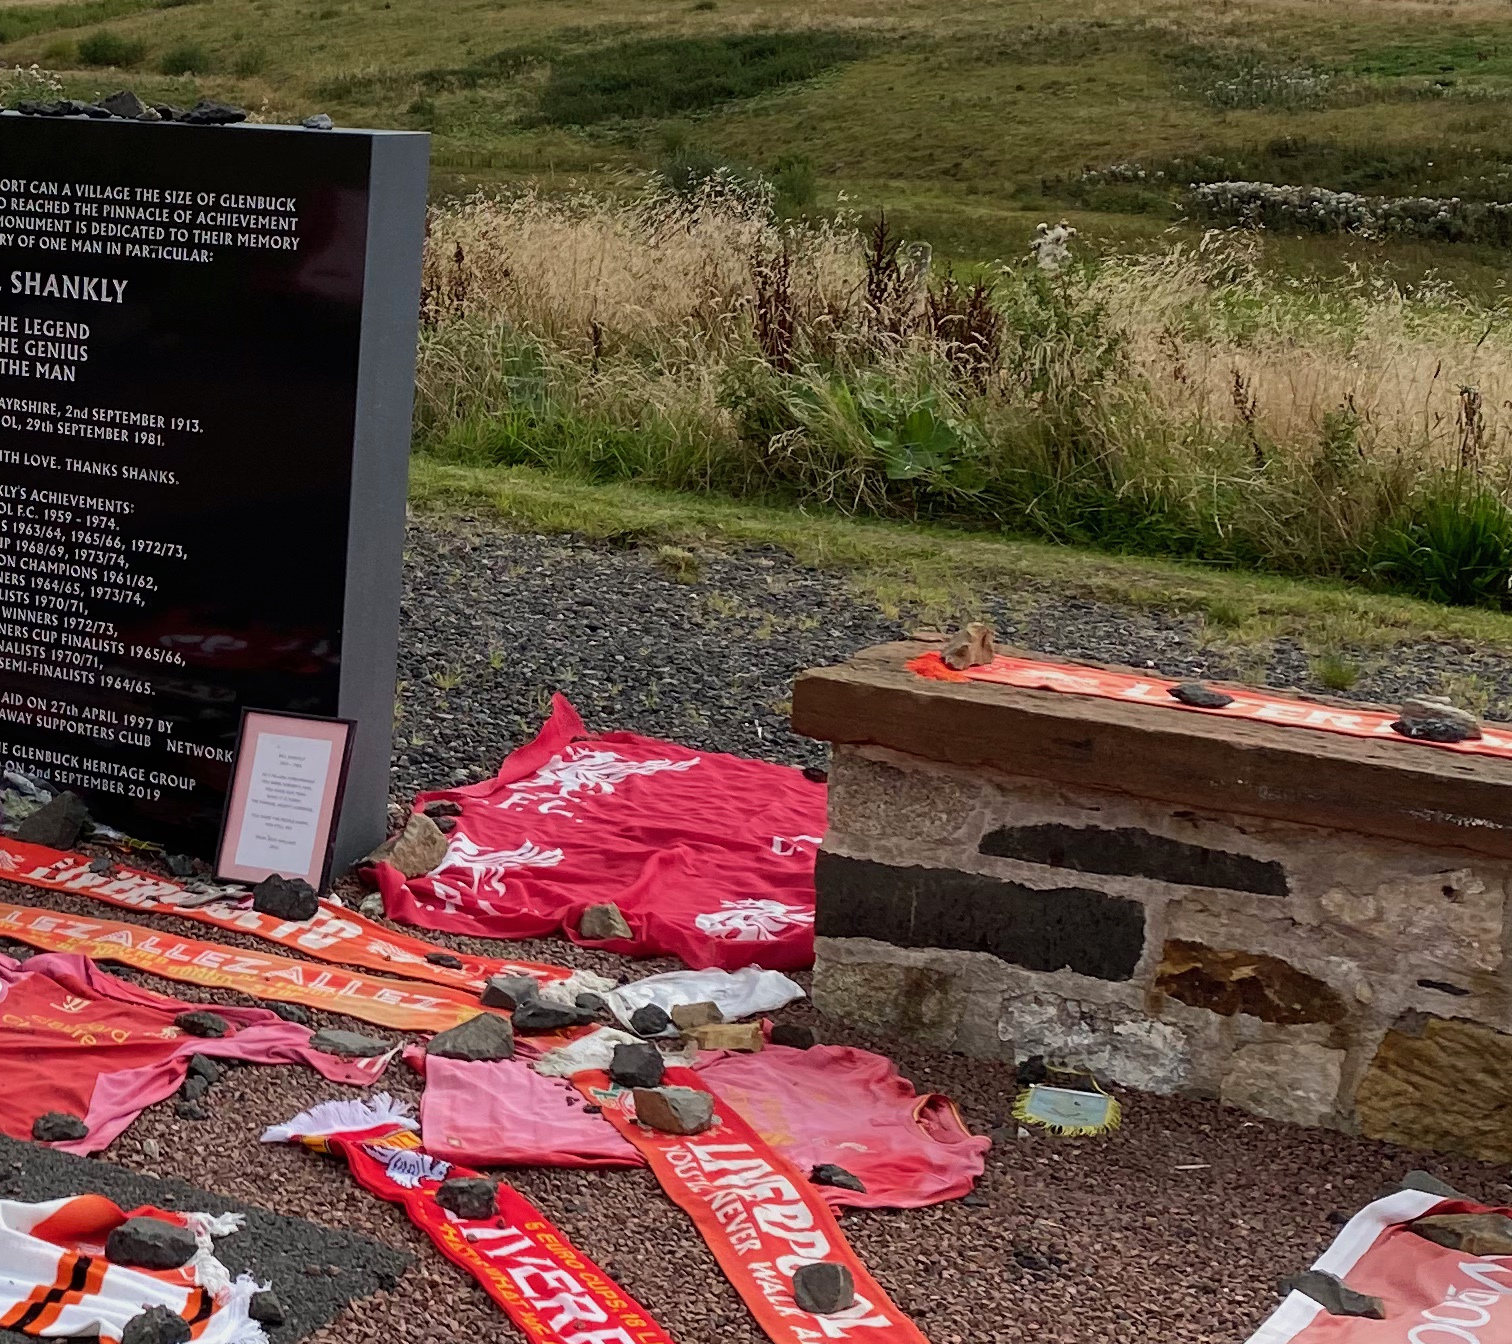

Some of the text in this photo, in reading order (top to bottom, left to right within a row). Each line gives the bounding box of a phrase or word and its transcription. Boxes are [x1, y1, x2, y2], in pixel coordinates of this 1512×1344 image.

[29, 180, 58, 195] CAN
[74, 183, 131, 201] VILLAGE
[133, 187, 160, 202] THE
[163, 189, 193, 205] SIZE
[196, 191, 216, 206] OF
[219, 192, 296, 212] GLENBUCK
[9, 196, 70, 214] REACHED
[72, 201, 98, 217] THE
[102, 203, 169, 222] PINNACLE
[195, 210, 299, 231] ACHIEVEMENT
[16, 234, 36, 248] OF
[38, 235, 67, 251] ONE
[70, 237, 102, 254] MAN
[105, 240, 121, 256] IN
[90, 221, 165, 240] DEDICATED
[168, 227, 189, 242] TO
[192, 228, 233, 246] THEIR
[236, 232, 300, 251] MEMORY
[9, 269, 129, 304] SHANKLY
[23, 317, 90, 340] LEGEND
[23, 339, 88, 362] GENIUS
[34, 361, 76, 382] MAN
[25, 416, 53, 433] 29th
[56, 420, 129, 442] SEPTEMBER
[64, 404, 89, 419] 2nd
[91, 407, 165, 428] SEPTEMBER
[64, 457, 118, 477] THANKS
[29, 488, 134, 514] ACHIEVEMENTS:
[43, 508, 72, 523] 1959
[12, 520, 66, 542] 1963/64,
[70, 529, 125, 551] 1965/66,
[131, 538, 187, 560] 1972/73,
[15, 538, 69, 560] 1968/69,
[73, 547, 129, 569] 1973/74,
[19, 556, 98, 580] CHAMPIONS
[102, 569, 158, 592] 1961/62,
[30, 576, 84, 598] 1964/65,
[89, 585, 145, 607] 1973/74,
[34, 594, 88, 615] 1970/71,
[0, 604, 59, 626] WINNERS
[63, 615, 118, 638] 1972/73,
[31, 627, 57, 643] CUP
[61, 632, 125, 655] FINALISTS
[129, 644, 186, 667] 1965/66,
[50, 648, 104, 670] 1970/71,
[100, 674, 155, 695] 1964/65.
[26, 695, 46, 711] ON
[49, 699, 78, 717] 27th
[80, 705, 118, 724] APRIL
[123, 713, 154, 730] 1997
[157, 718, 174, 734] BY
[35, 713, 115, 741] SUPPORTERS
[117, 729, 151, 747] CLUB
[166, 737, 234, 763] NETWORK
[11, 743, 79, 768] GLENBUCK
[82, 756, 145, 781] HERITAGE
[148, 770, 196, 791] GROUP
[54, 769, 125, 795] SEPTEMBER
[127, 783, 161, 802] 2019
[537, 1233, 585, 1270] EURO
[702, 1188, 763, 1256] NEVER
[747, 1260, 808, 1319] WALK
